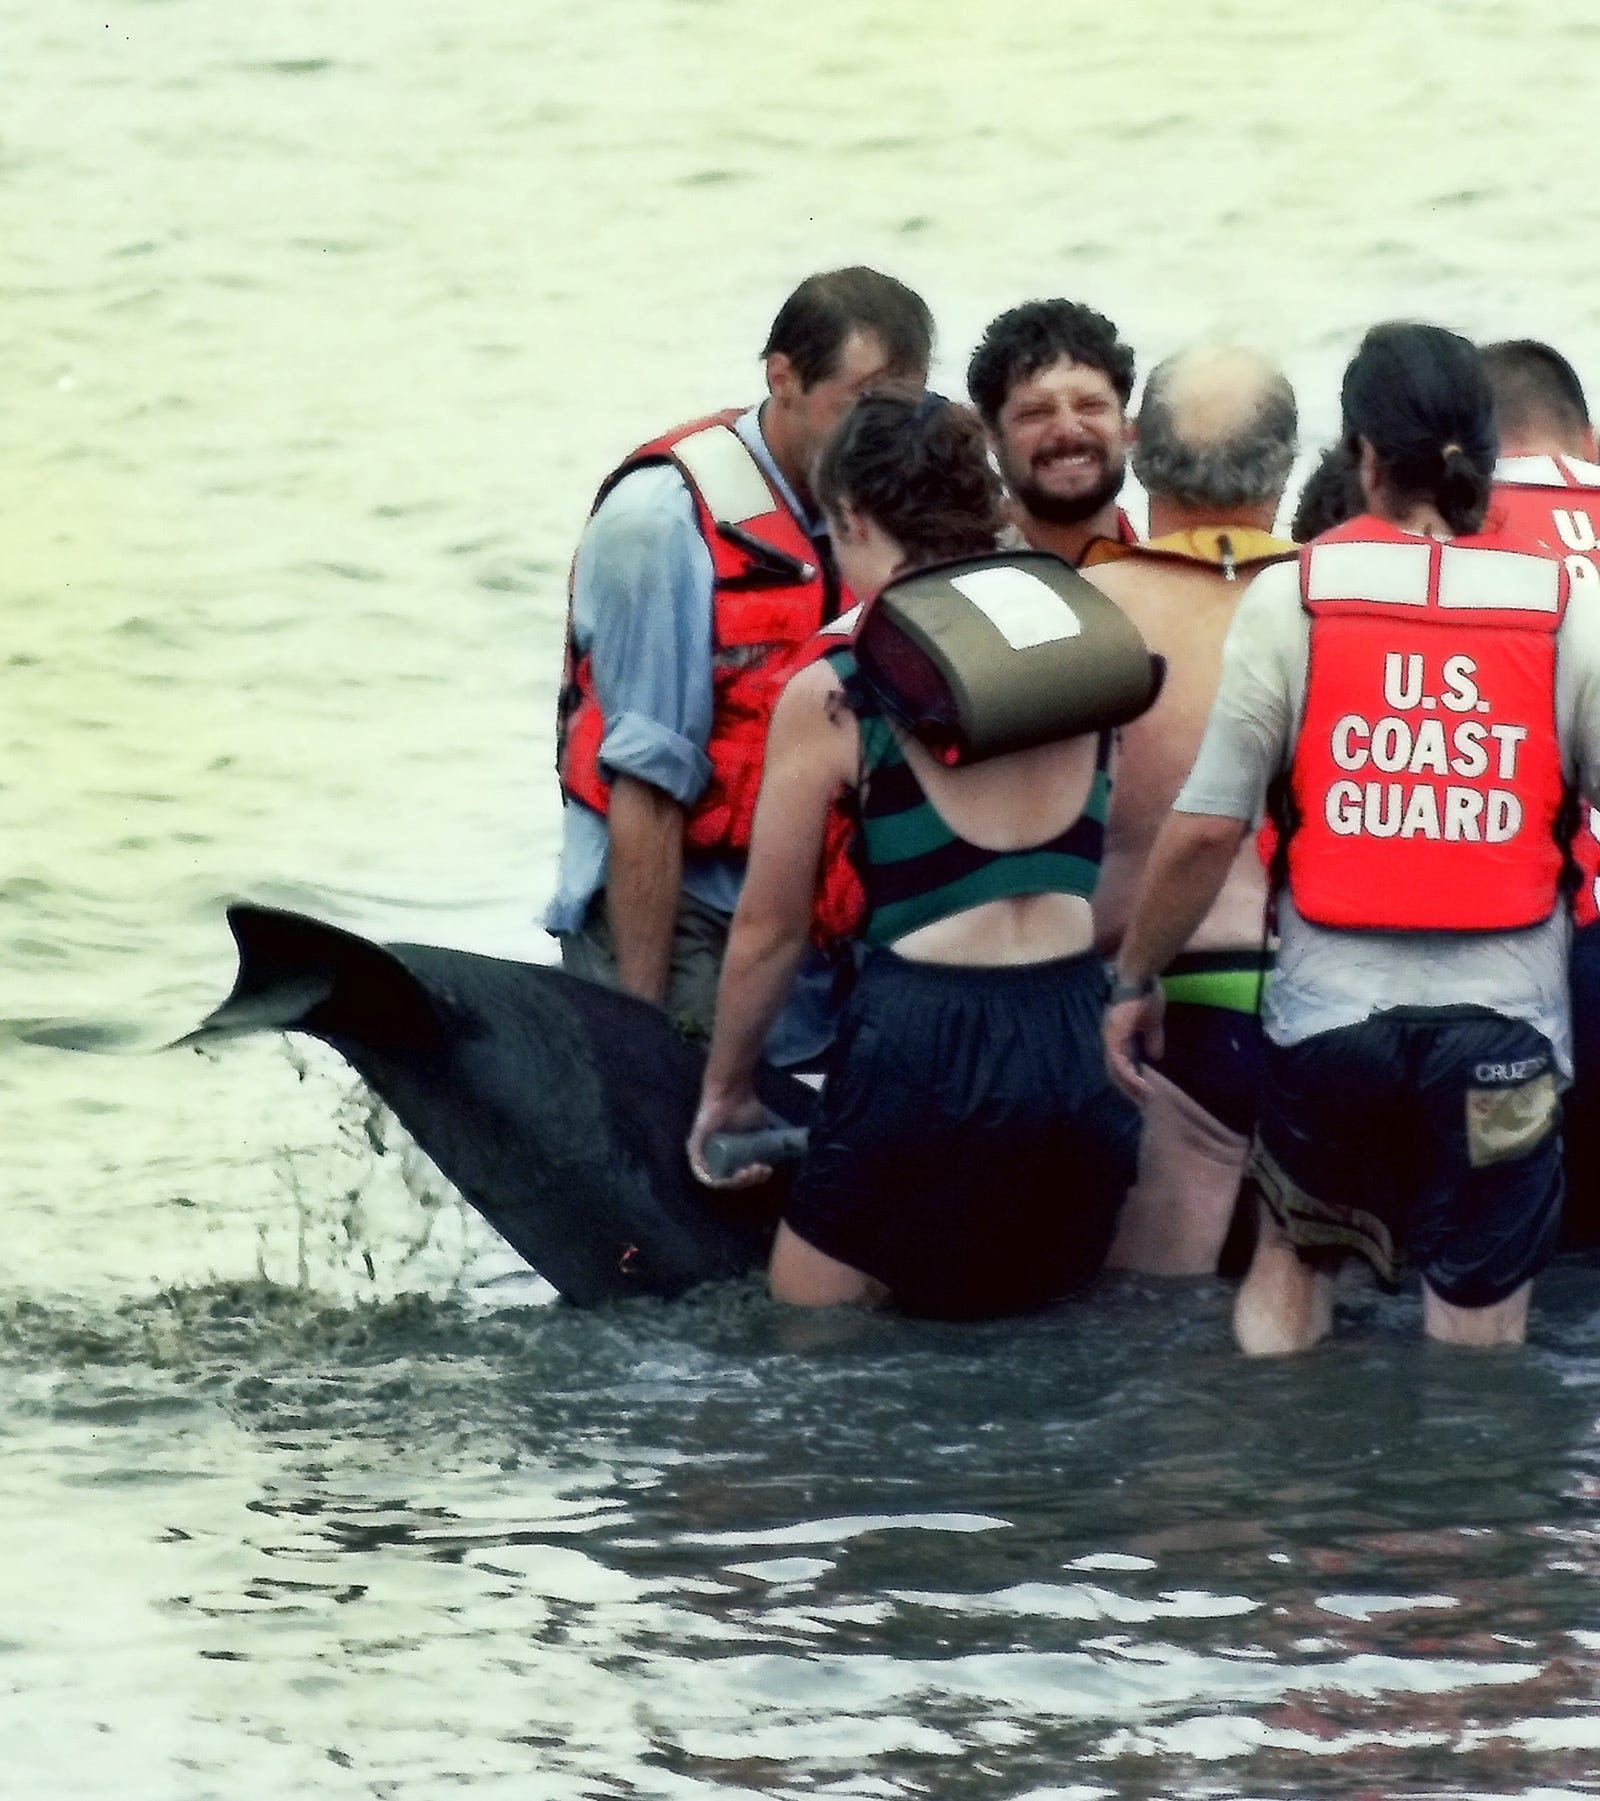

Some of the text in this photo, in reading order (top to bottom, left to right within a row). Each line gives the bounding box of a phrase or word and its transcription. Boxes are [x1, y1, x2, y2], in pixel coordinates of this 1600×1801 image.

[1384, 653, 1490, 713] U.S.
[1331, 714, 1527, 779] COAST
[1325, 780, 1523, 844] GUARD
